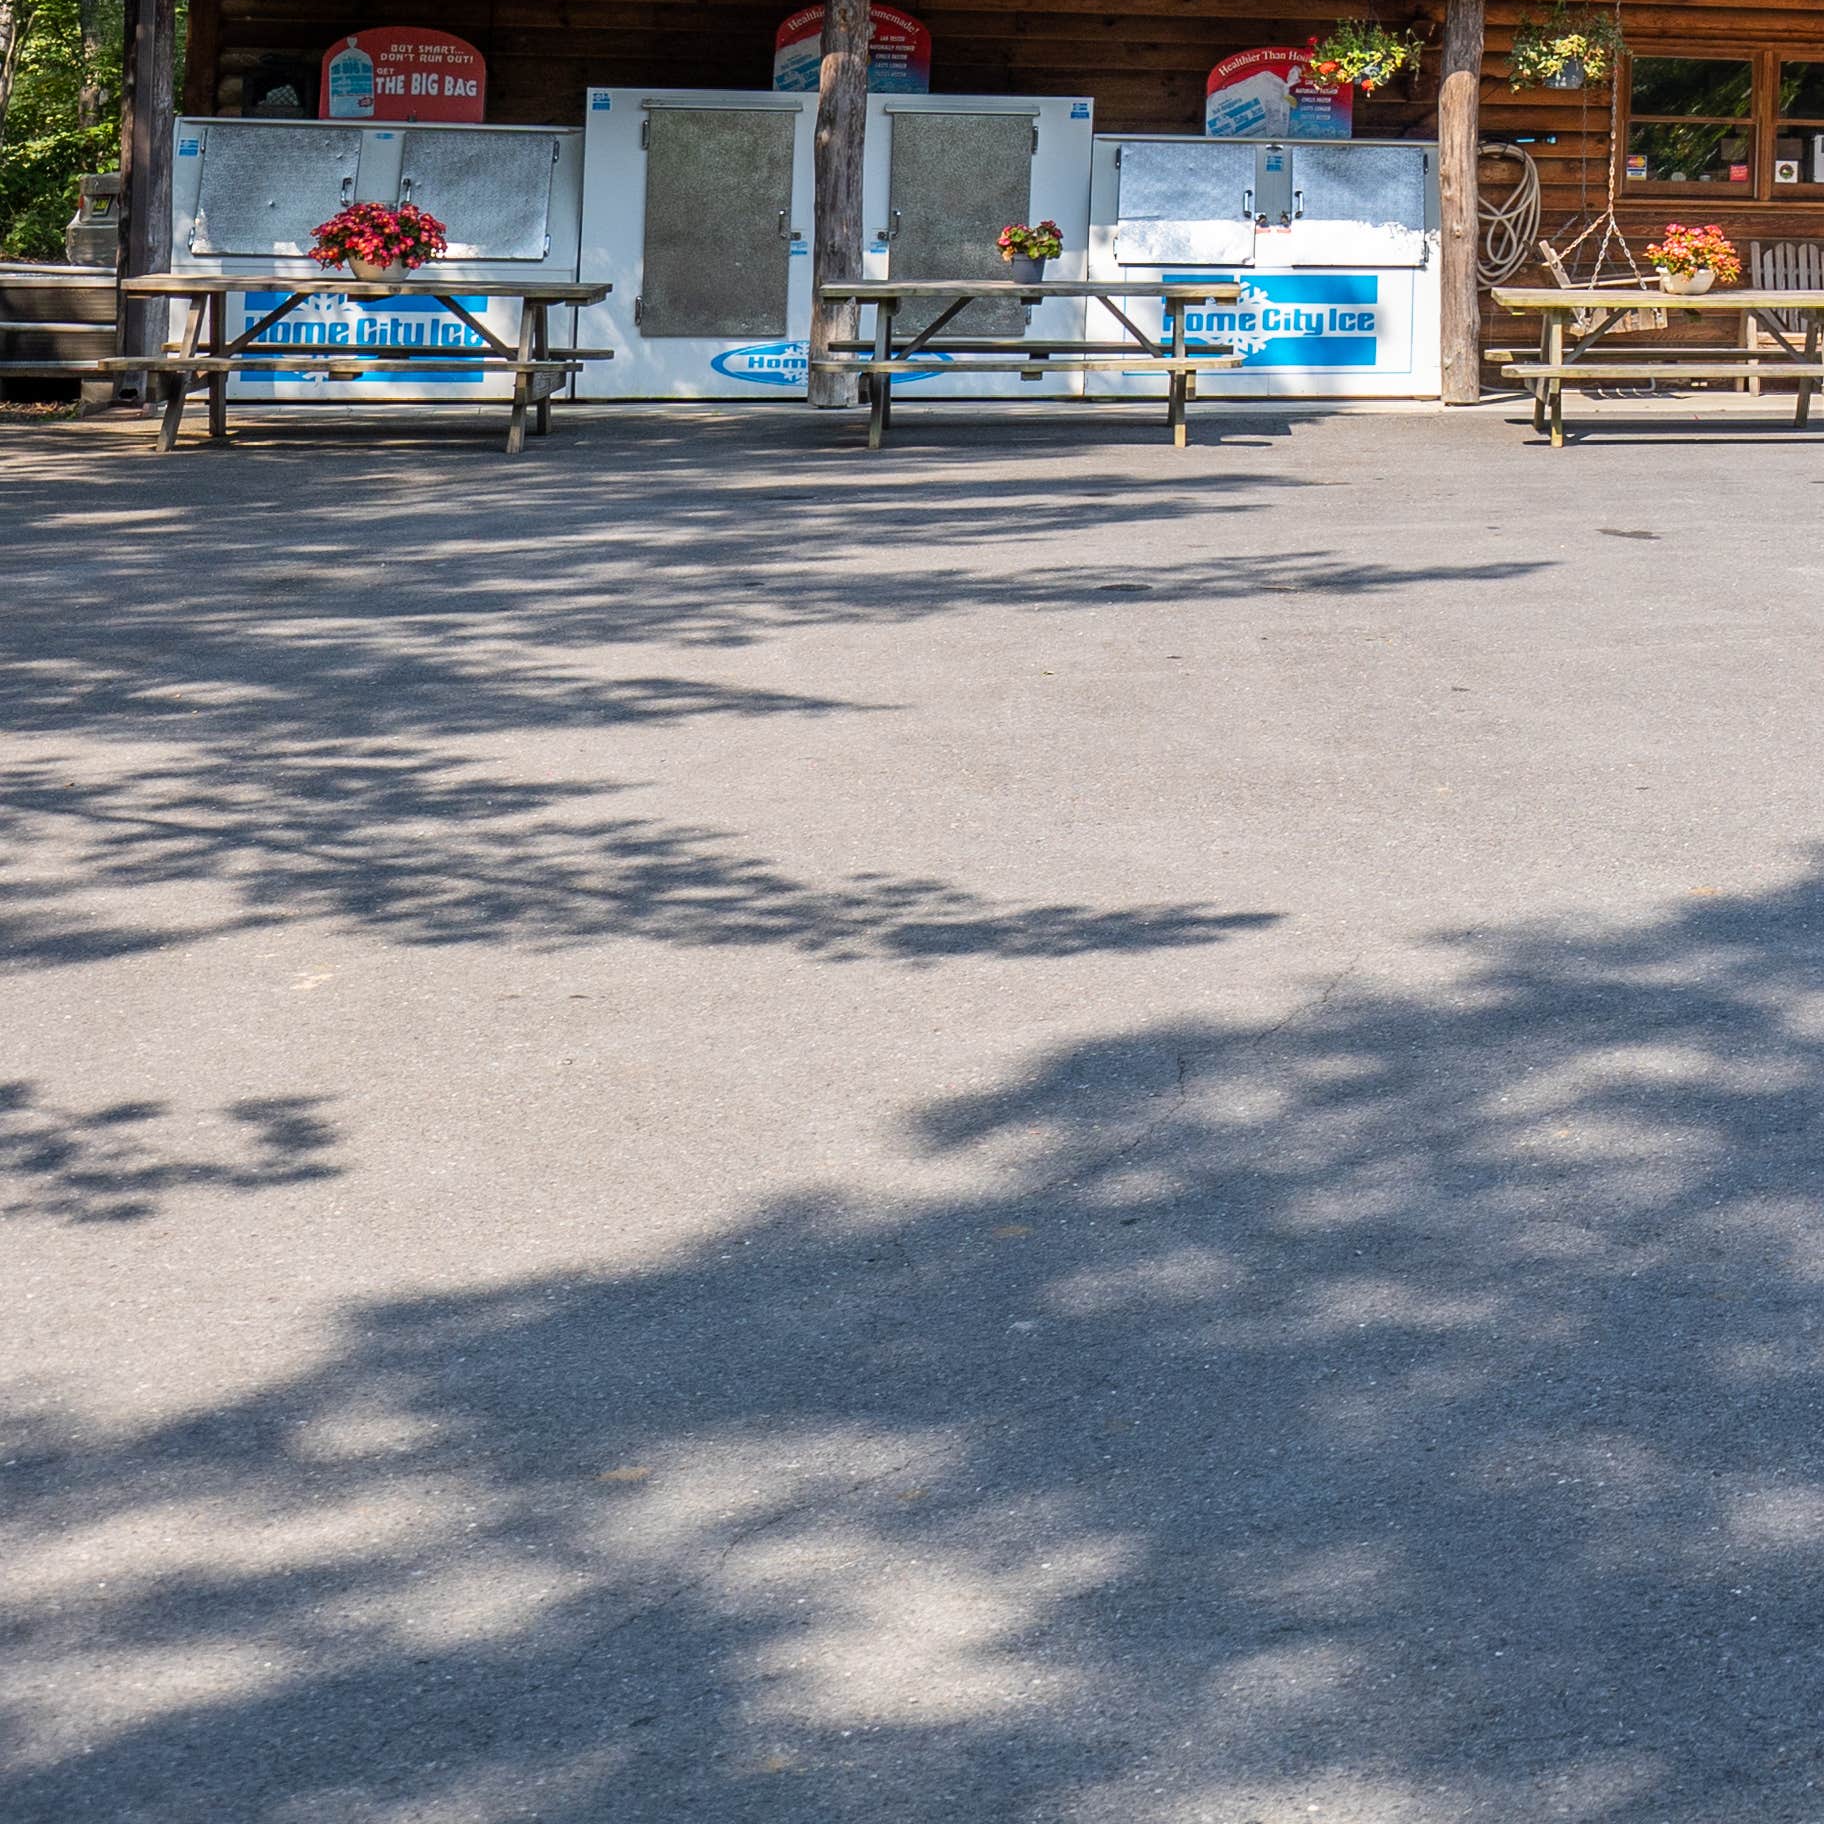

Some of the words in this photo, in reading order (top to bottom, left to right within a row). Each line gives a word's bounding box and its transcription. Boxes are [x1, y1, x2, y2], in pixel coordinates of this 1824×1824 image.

[788, 7, 825, 31] Healthi
[869, 9, 920, 35] omemade!
[380, 53, 415, 62] DON'T
[420, 54, 442, 63] RUN
[447, 55, 474, 64] OUT!
[391, 44, 414, 53] BUY
[376, 67, 395, 75] GET
[1218, 53, 1260, 77] Healthier
[1262, 51, 1286, 60] Than
[376, 75, 405, 95] THE
[411, 72, 439, 96] BIG
[444, 77, 478, 97] BAG
[356, 318, 424, 345] City
[431, 319, 484, 346] Ice
[1262, 308, 1324, 336] City
[1329, 308, 1375, 332] Ice
[748, 356, 807, 369] Hom
